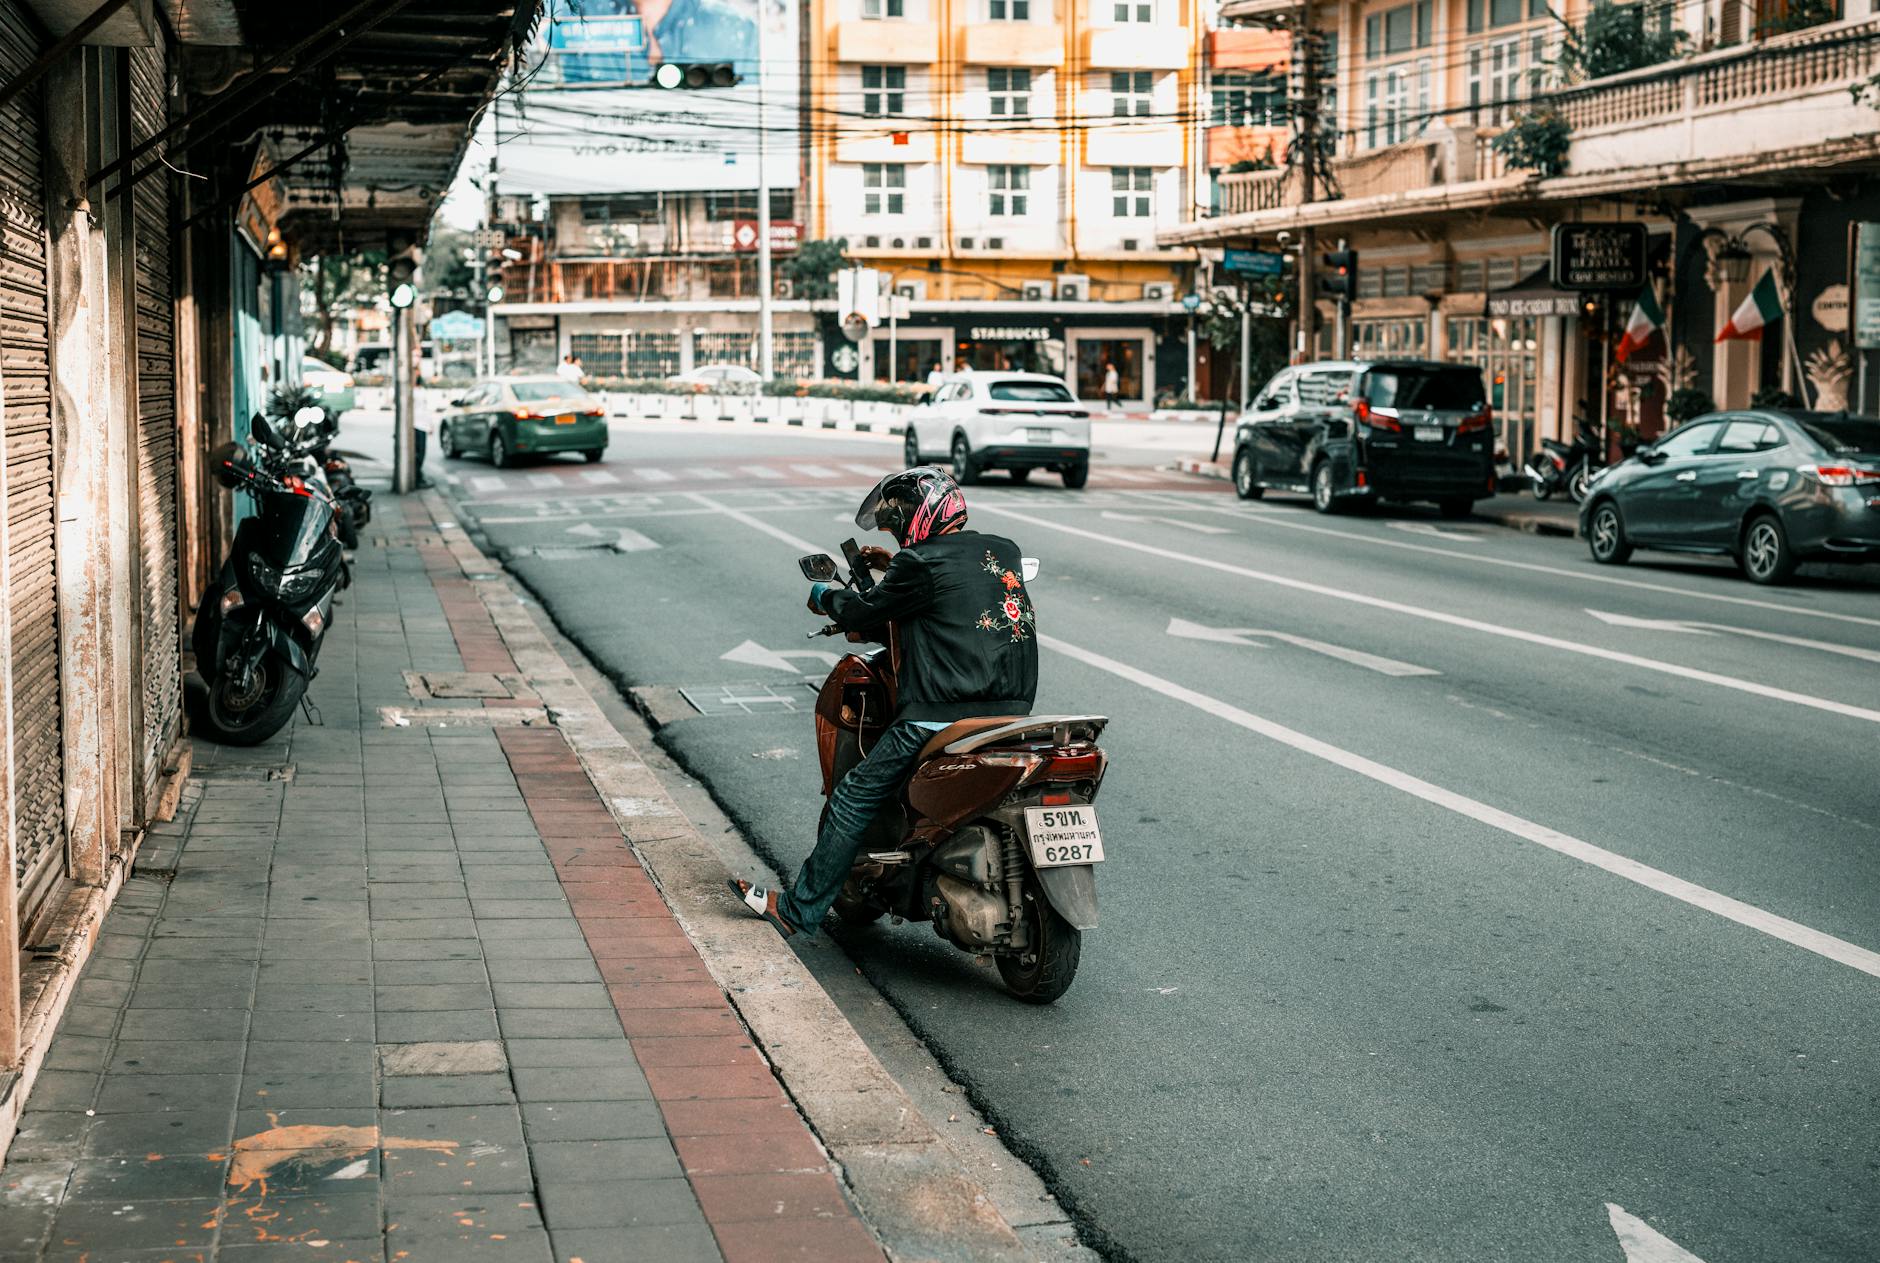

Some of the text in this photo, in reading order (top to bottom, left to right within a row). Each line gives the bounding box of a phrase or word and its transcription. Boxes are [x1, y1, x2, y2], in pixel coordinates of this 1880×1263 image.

[573, 143, 617, 155] vivo
[971, 327, 1050, 340] STARBUCKS
[1043, 811, 1082, 827] 5ขท
[1033, 831, 1097, 845] กรุงเทพมหานคร
[1046, 845, 1093, 862] 6287
